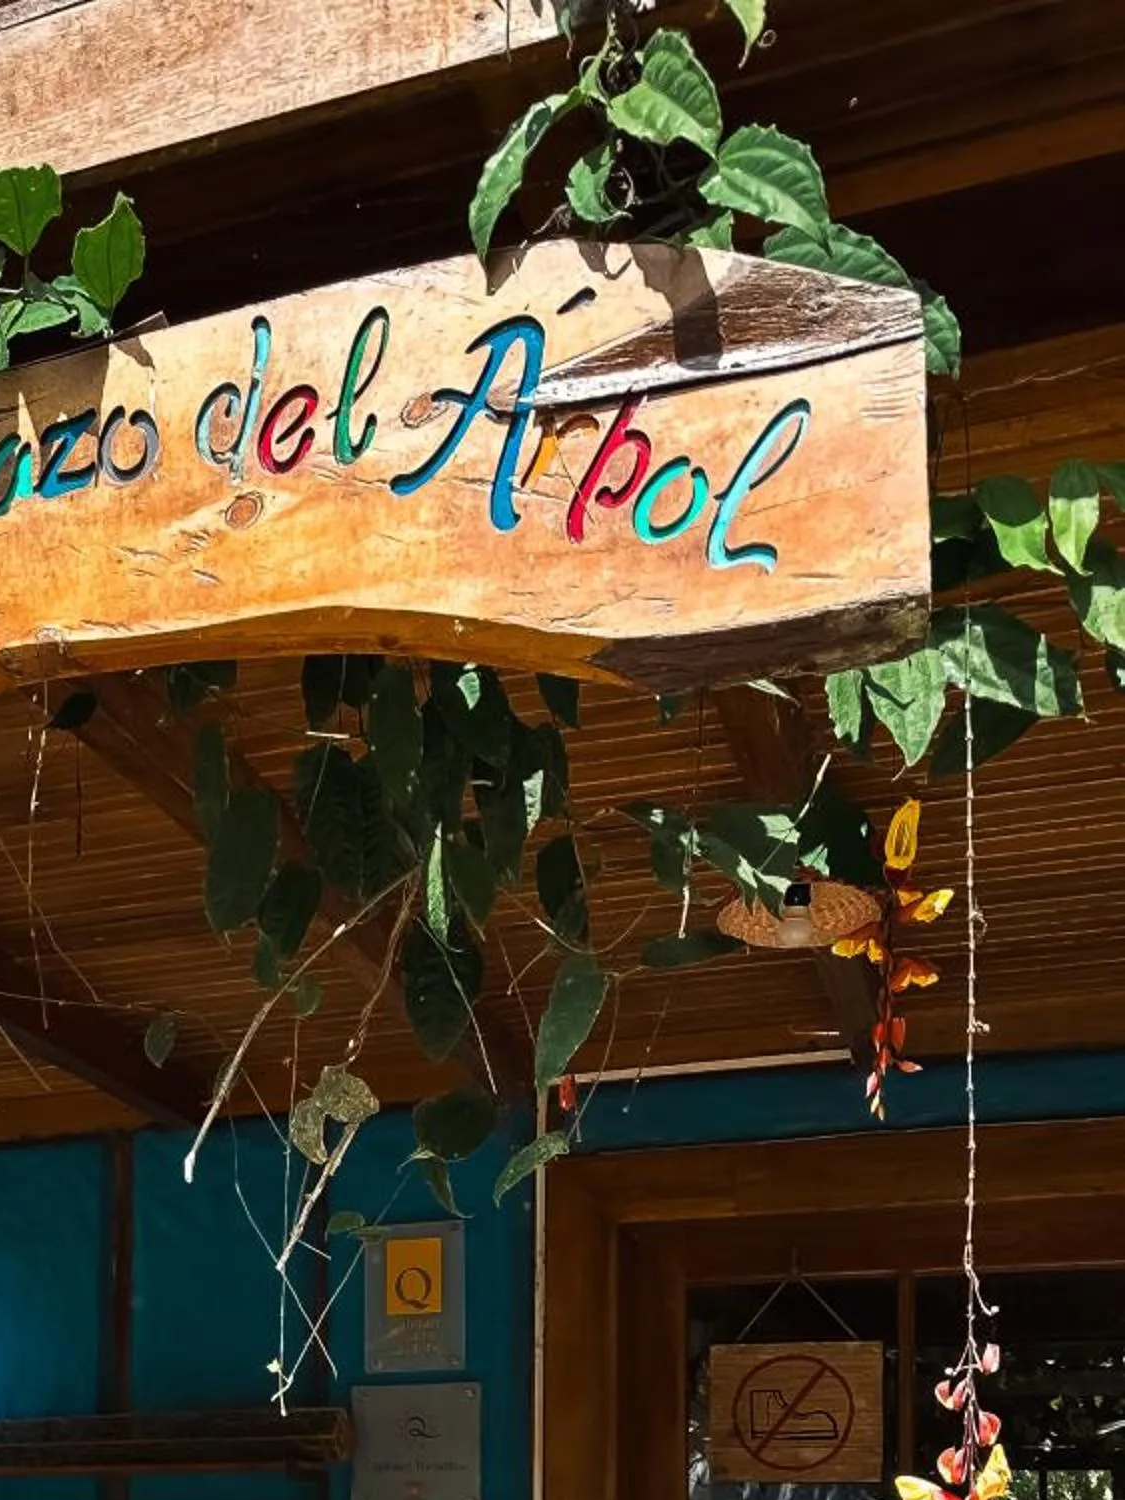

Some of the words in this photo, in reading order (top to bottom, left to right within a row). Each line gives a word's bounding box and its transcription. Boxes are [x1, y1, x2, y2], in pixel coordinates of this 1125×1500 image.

[195, 305, 390, 485] del
[389, 286, 812, 576] Árbol
[394, 1266, 432, 1310] Q
